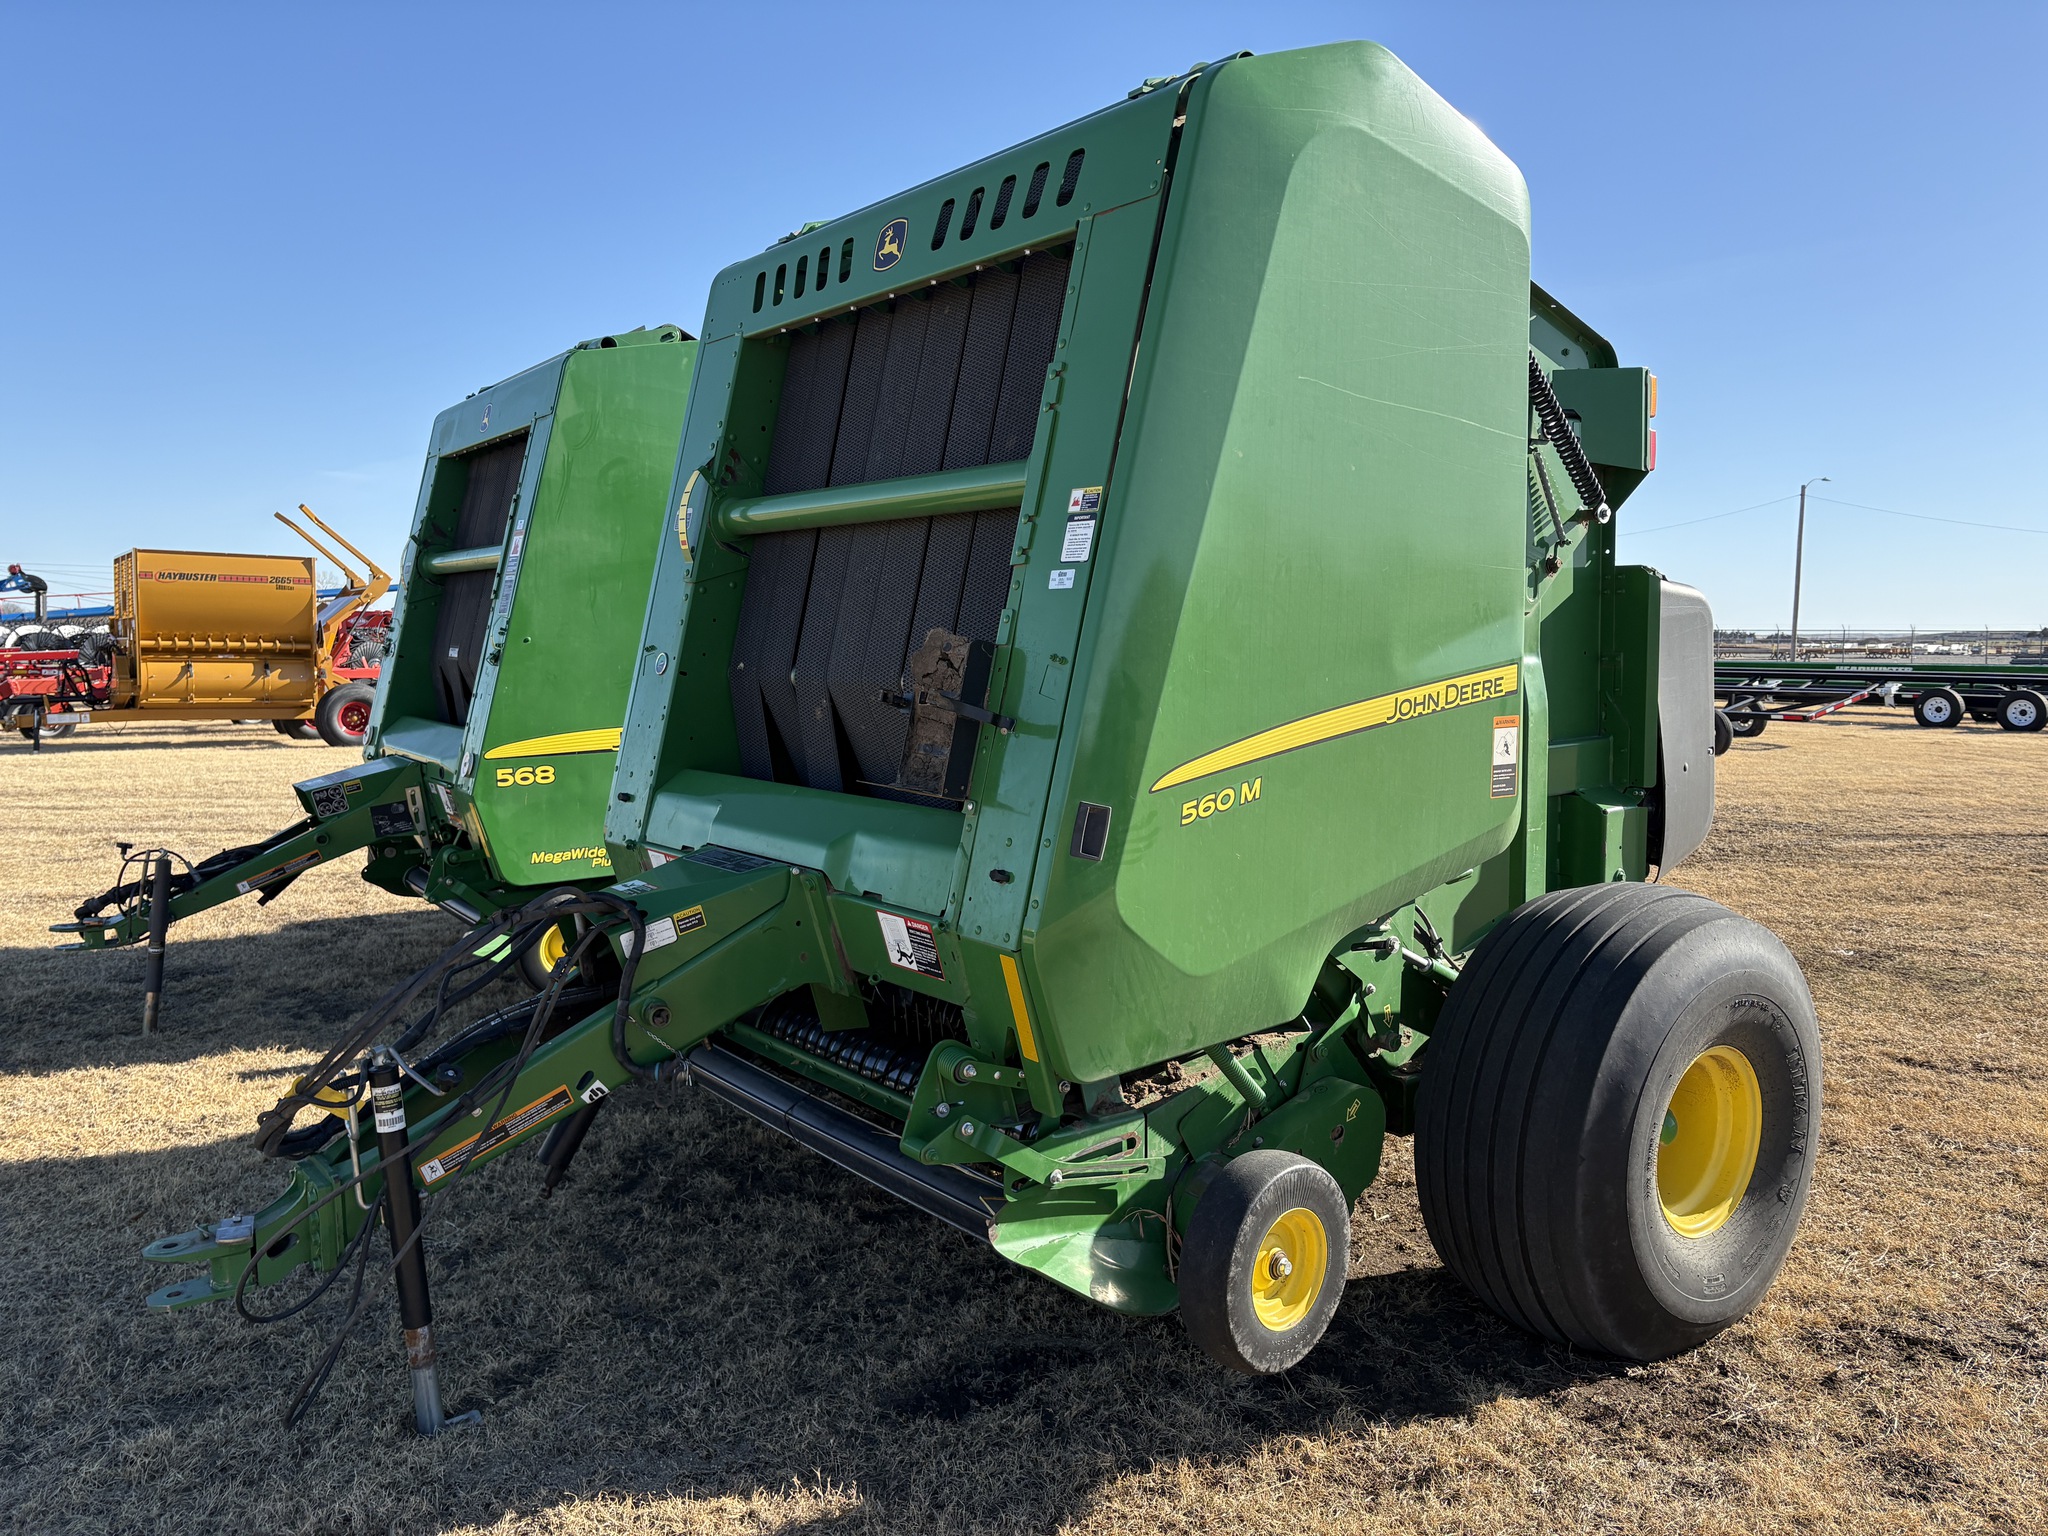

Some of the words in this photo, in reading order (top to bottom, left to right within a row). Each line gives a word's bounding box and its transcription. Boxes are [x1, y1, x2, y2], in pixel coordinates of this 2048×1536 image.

[158, 572, 217, 581] HAYBUSTER
[269, 576, 292, 584] 2665
[1386, 691, 1440, 721] JOHN
[1445, 676, 1504, 706] DEERE
[496, 765, 555, 787] 568
[1180, 786, 1236, 827] 560
[1239, 776, 1262, 806] M
[531, 847, 606, 864] MegaWide
[591, 857, 611, 868] Plu
[679, 907, 701, 918] CAUTION
[1786, 1044, 1808, 1156] TITAN
